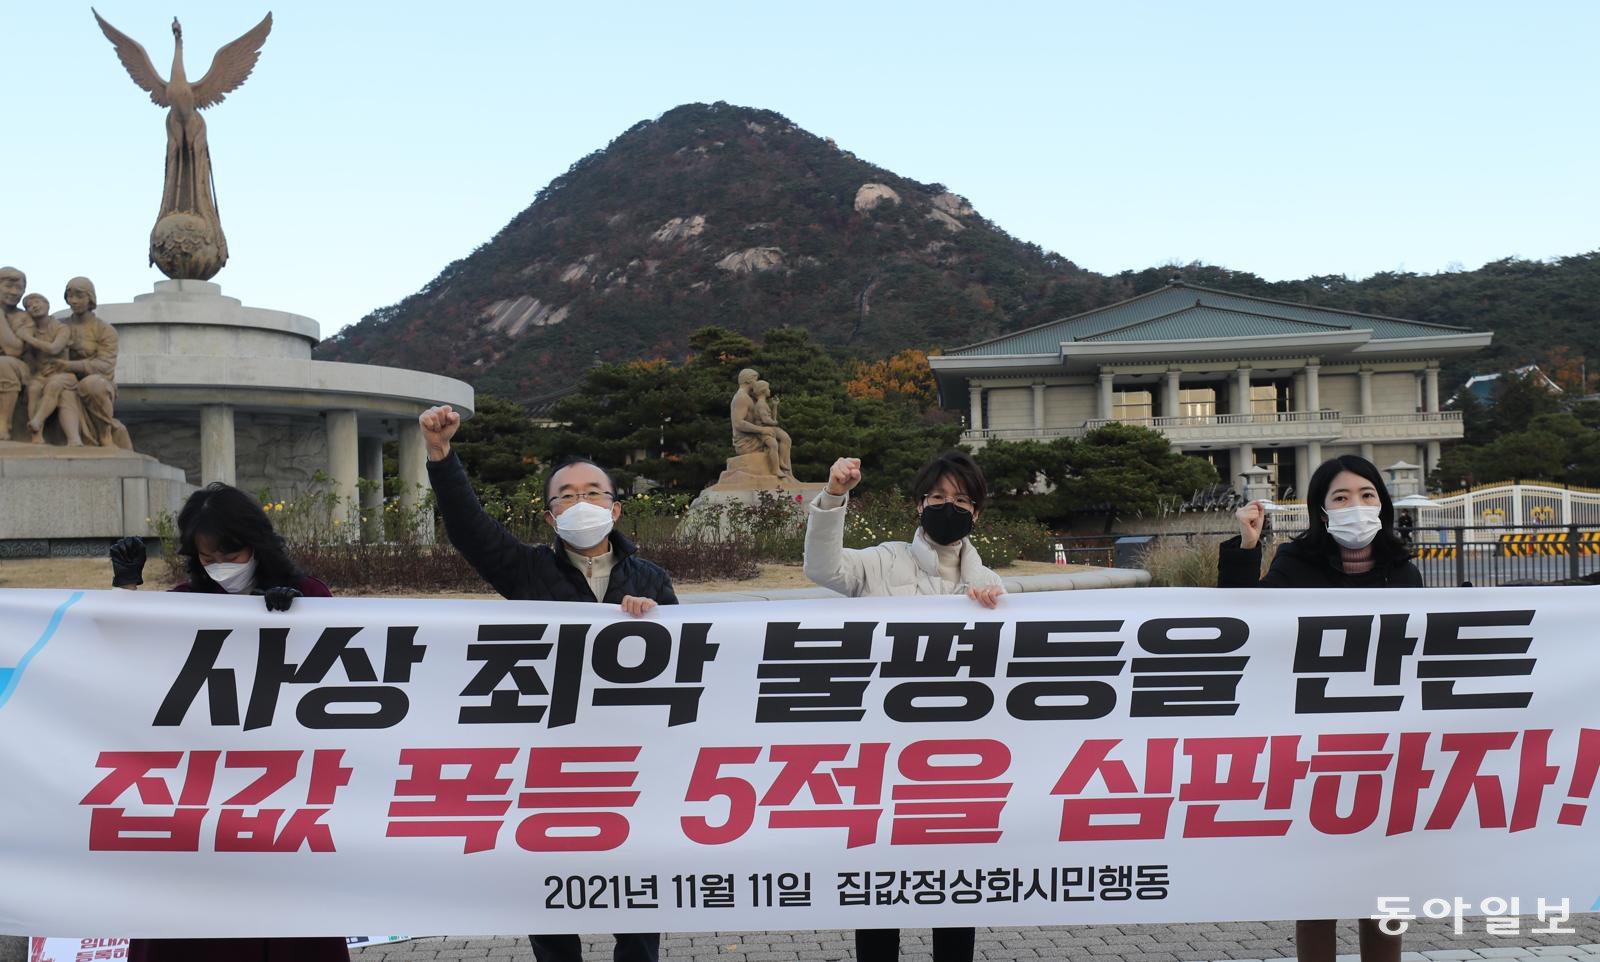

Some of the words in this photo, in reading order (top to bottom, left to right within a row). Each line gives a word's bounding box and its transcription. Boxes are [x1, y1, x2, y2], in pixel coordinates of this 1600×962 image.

[152, 626, 427, 731] 사상
[458, 622, 720, 728] 최악
[756, 616, 1251, 723] 불평등을
[1293, 610, 1537, 715] 만든
[79, 749, 354, 853] 집값
[385, 745, 642, 854] 폭등
[680, 738, 1013, 849] 5적을
[1050, 727, 1600, 841] 심판하자!
[544, 874, 659, 910] 2021년
[672, 873, 735, 909] 11월
[748, 872, 812, 908] 11일
[837, 864, 1170, 906] 집값정상화시민행동
